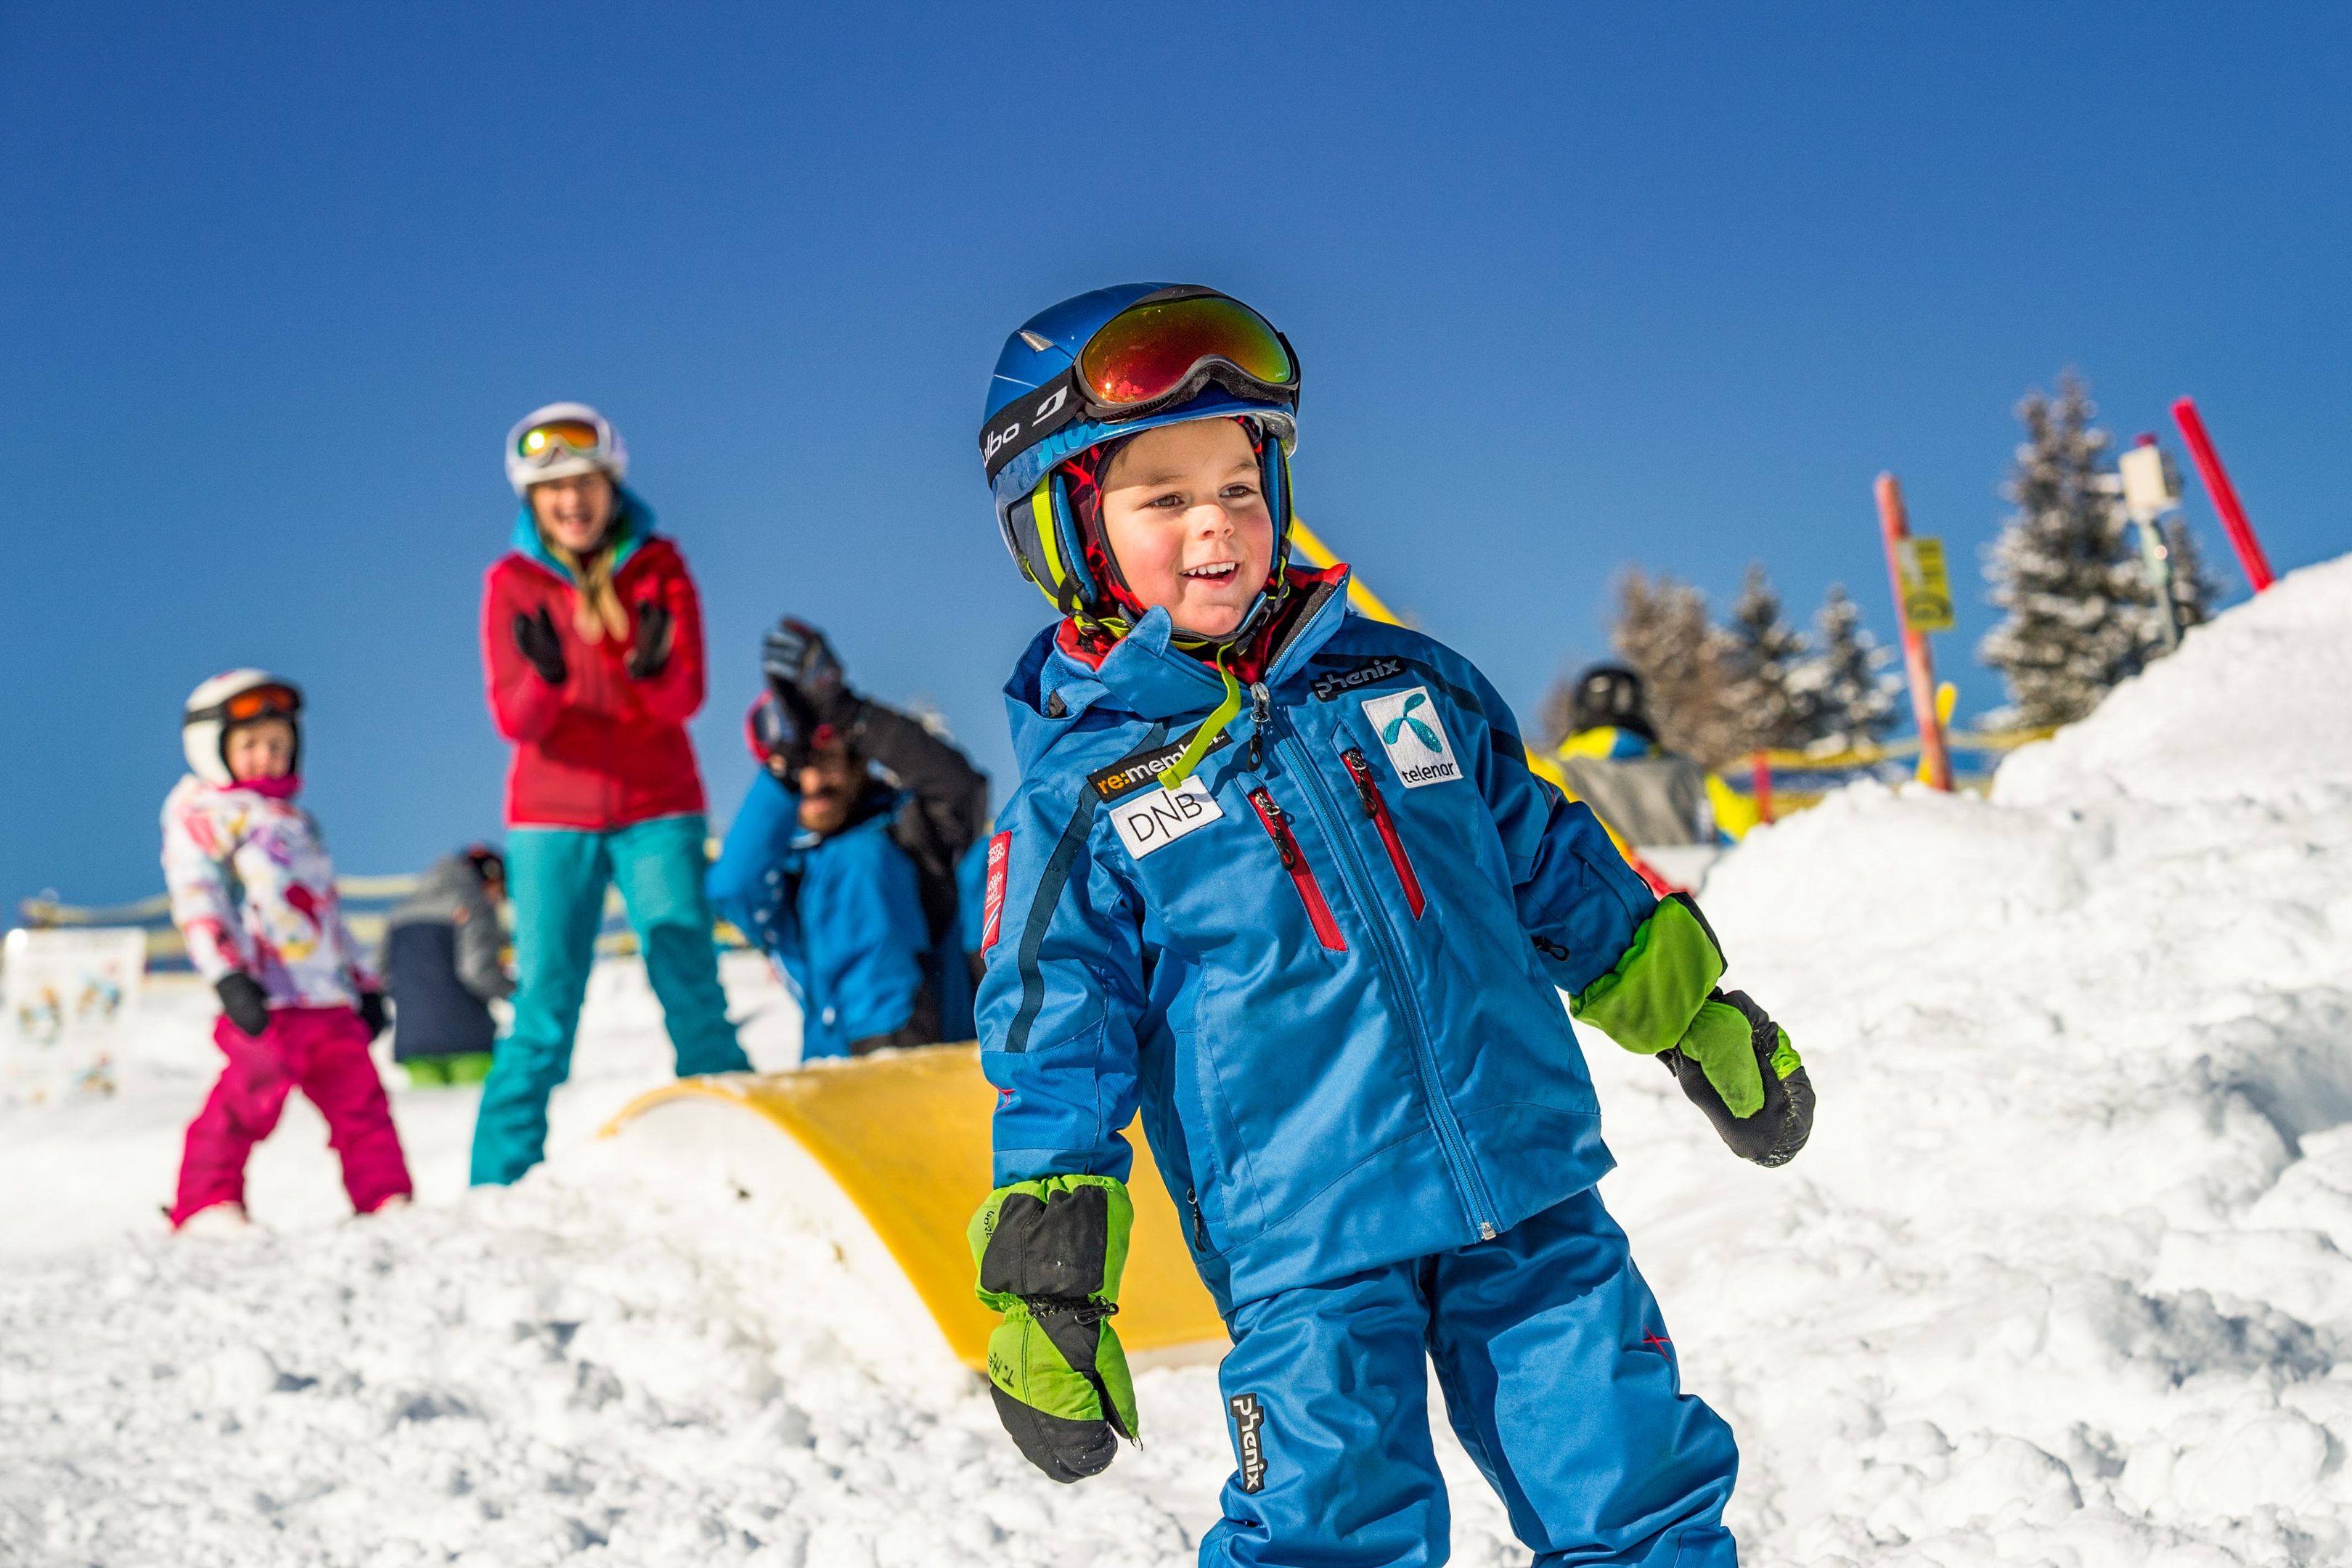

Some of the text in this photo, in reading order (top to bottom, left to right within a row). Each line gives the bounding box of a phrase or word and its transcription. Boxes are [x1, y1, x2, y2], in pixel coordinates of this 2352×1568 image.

[979, 422, 1020, 468] ulbo
[1315, 659, 1401, 698] phenix
[1402, 762, 1455, 783] telenor
[1127, 790, 1203, 842] DNB
[1233, 1397, 1265, 1490] phenix
